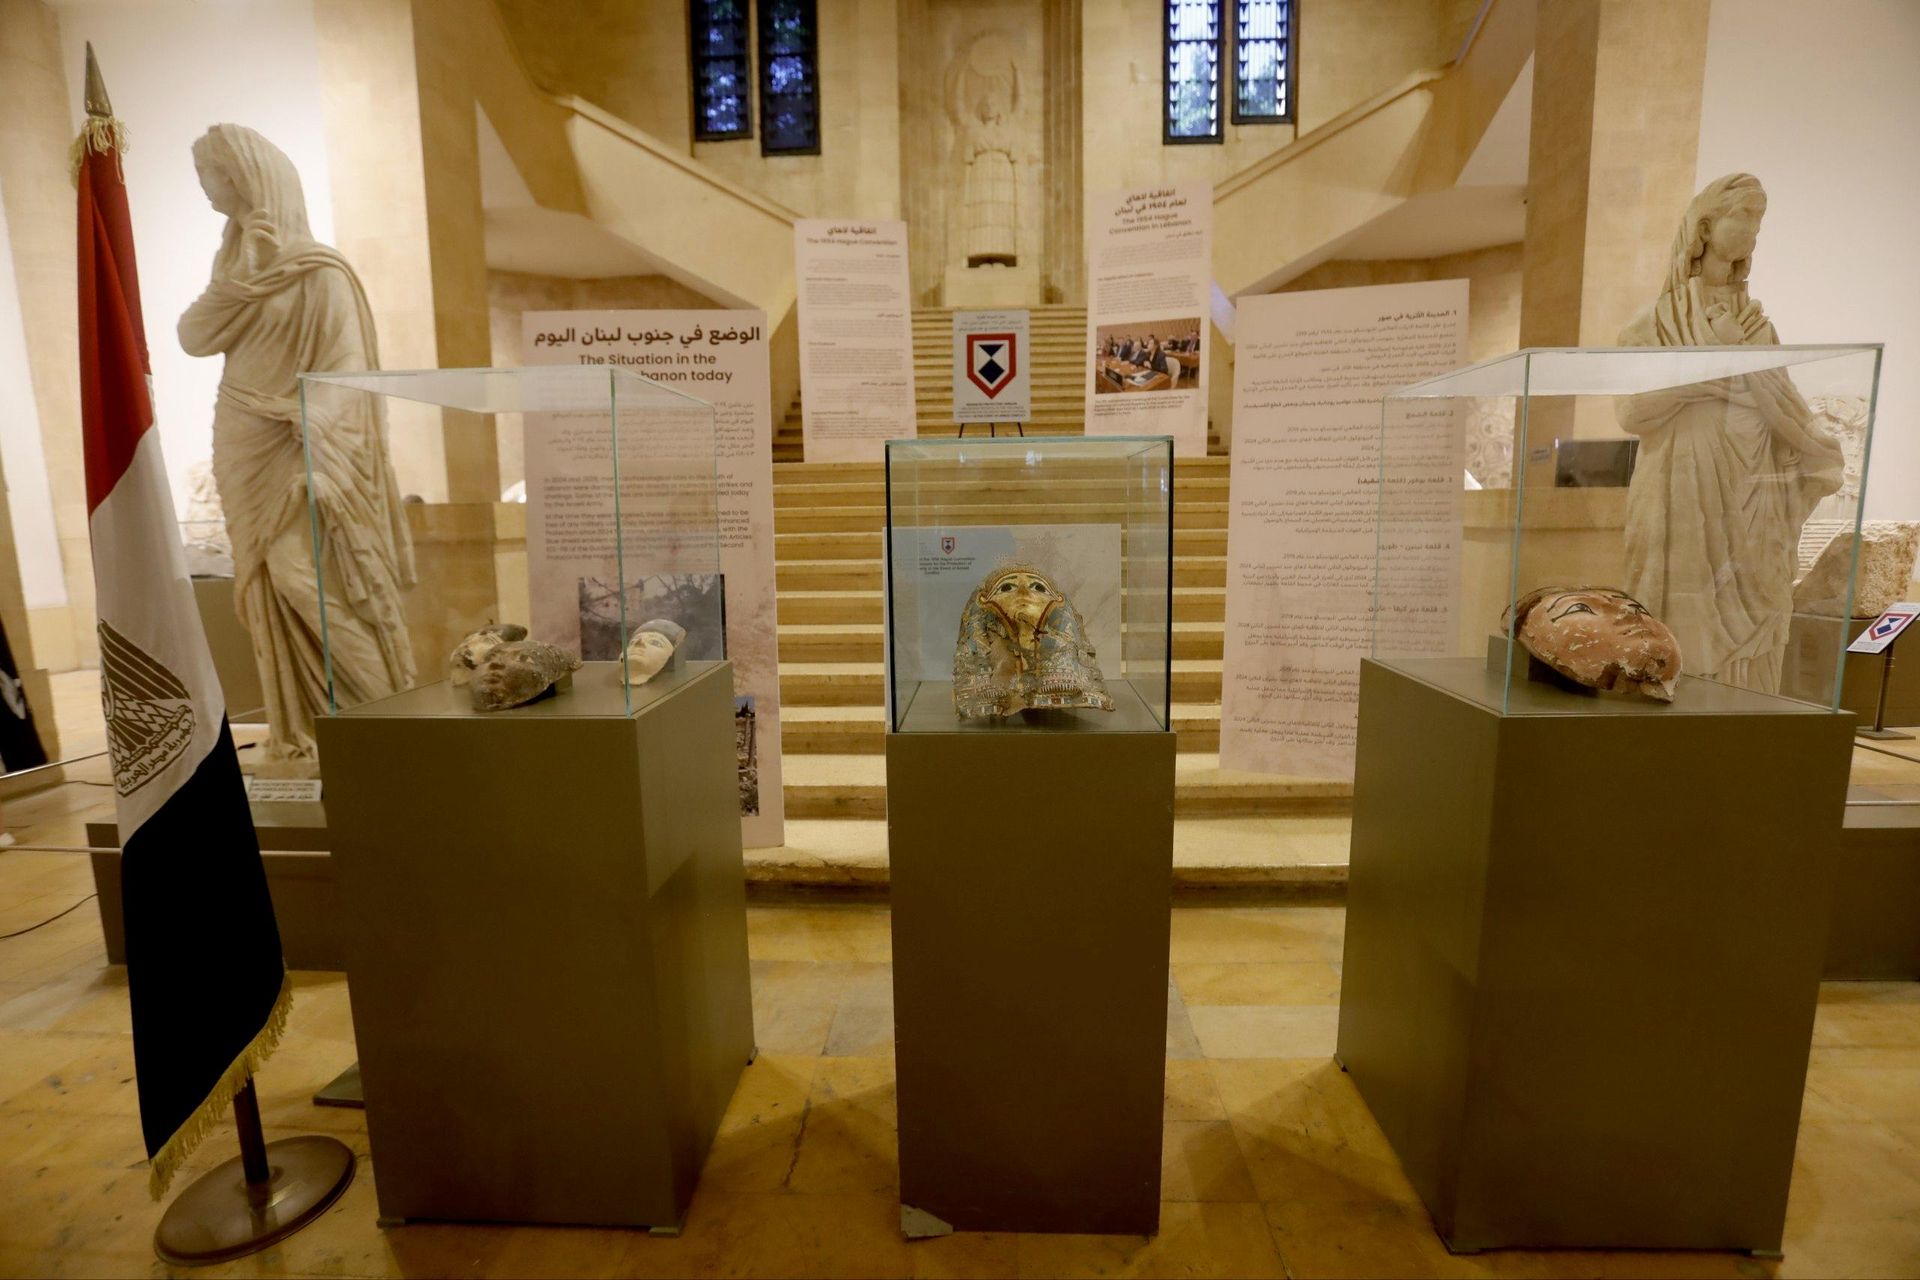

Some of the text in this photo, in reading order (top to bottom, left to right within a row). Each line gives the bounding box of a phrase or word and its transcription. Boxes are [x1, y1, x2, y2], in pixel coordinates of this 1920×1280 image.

[1148, 187, 1176, 200] اتفاقية
[534, 324, 761, 348] الوضع في جنوب لبنان اليوم
[578, 353, 716, 365] The Situation in the
[691, 370, 733, 384] today
